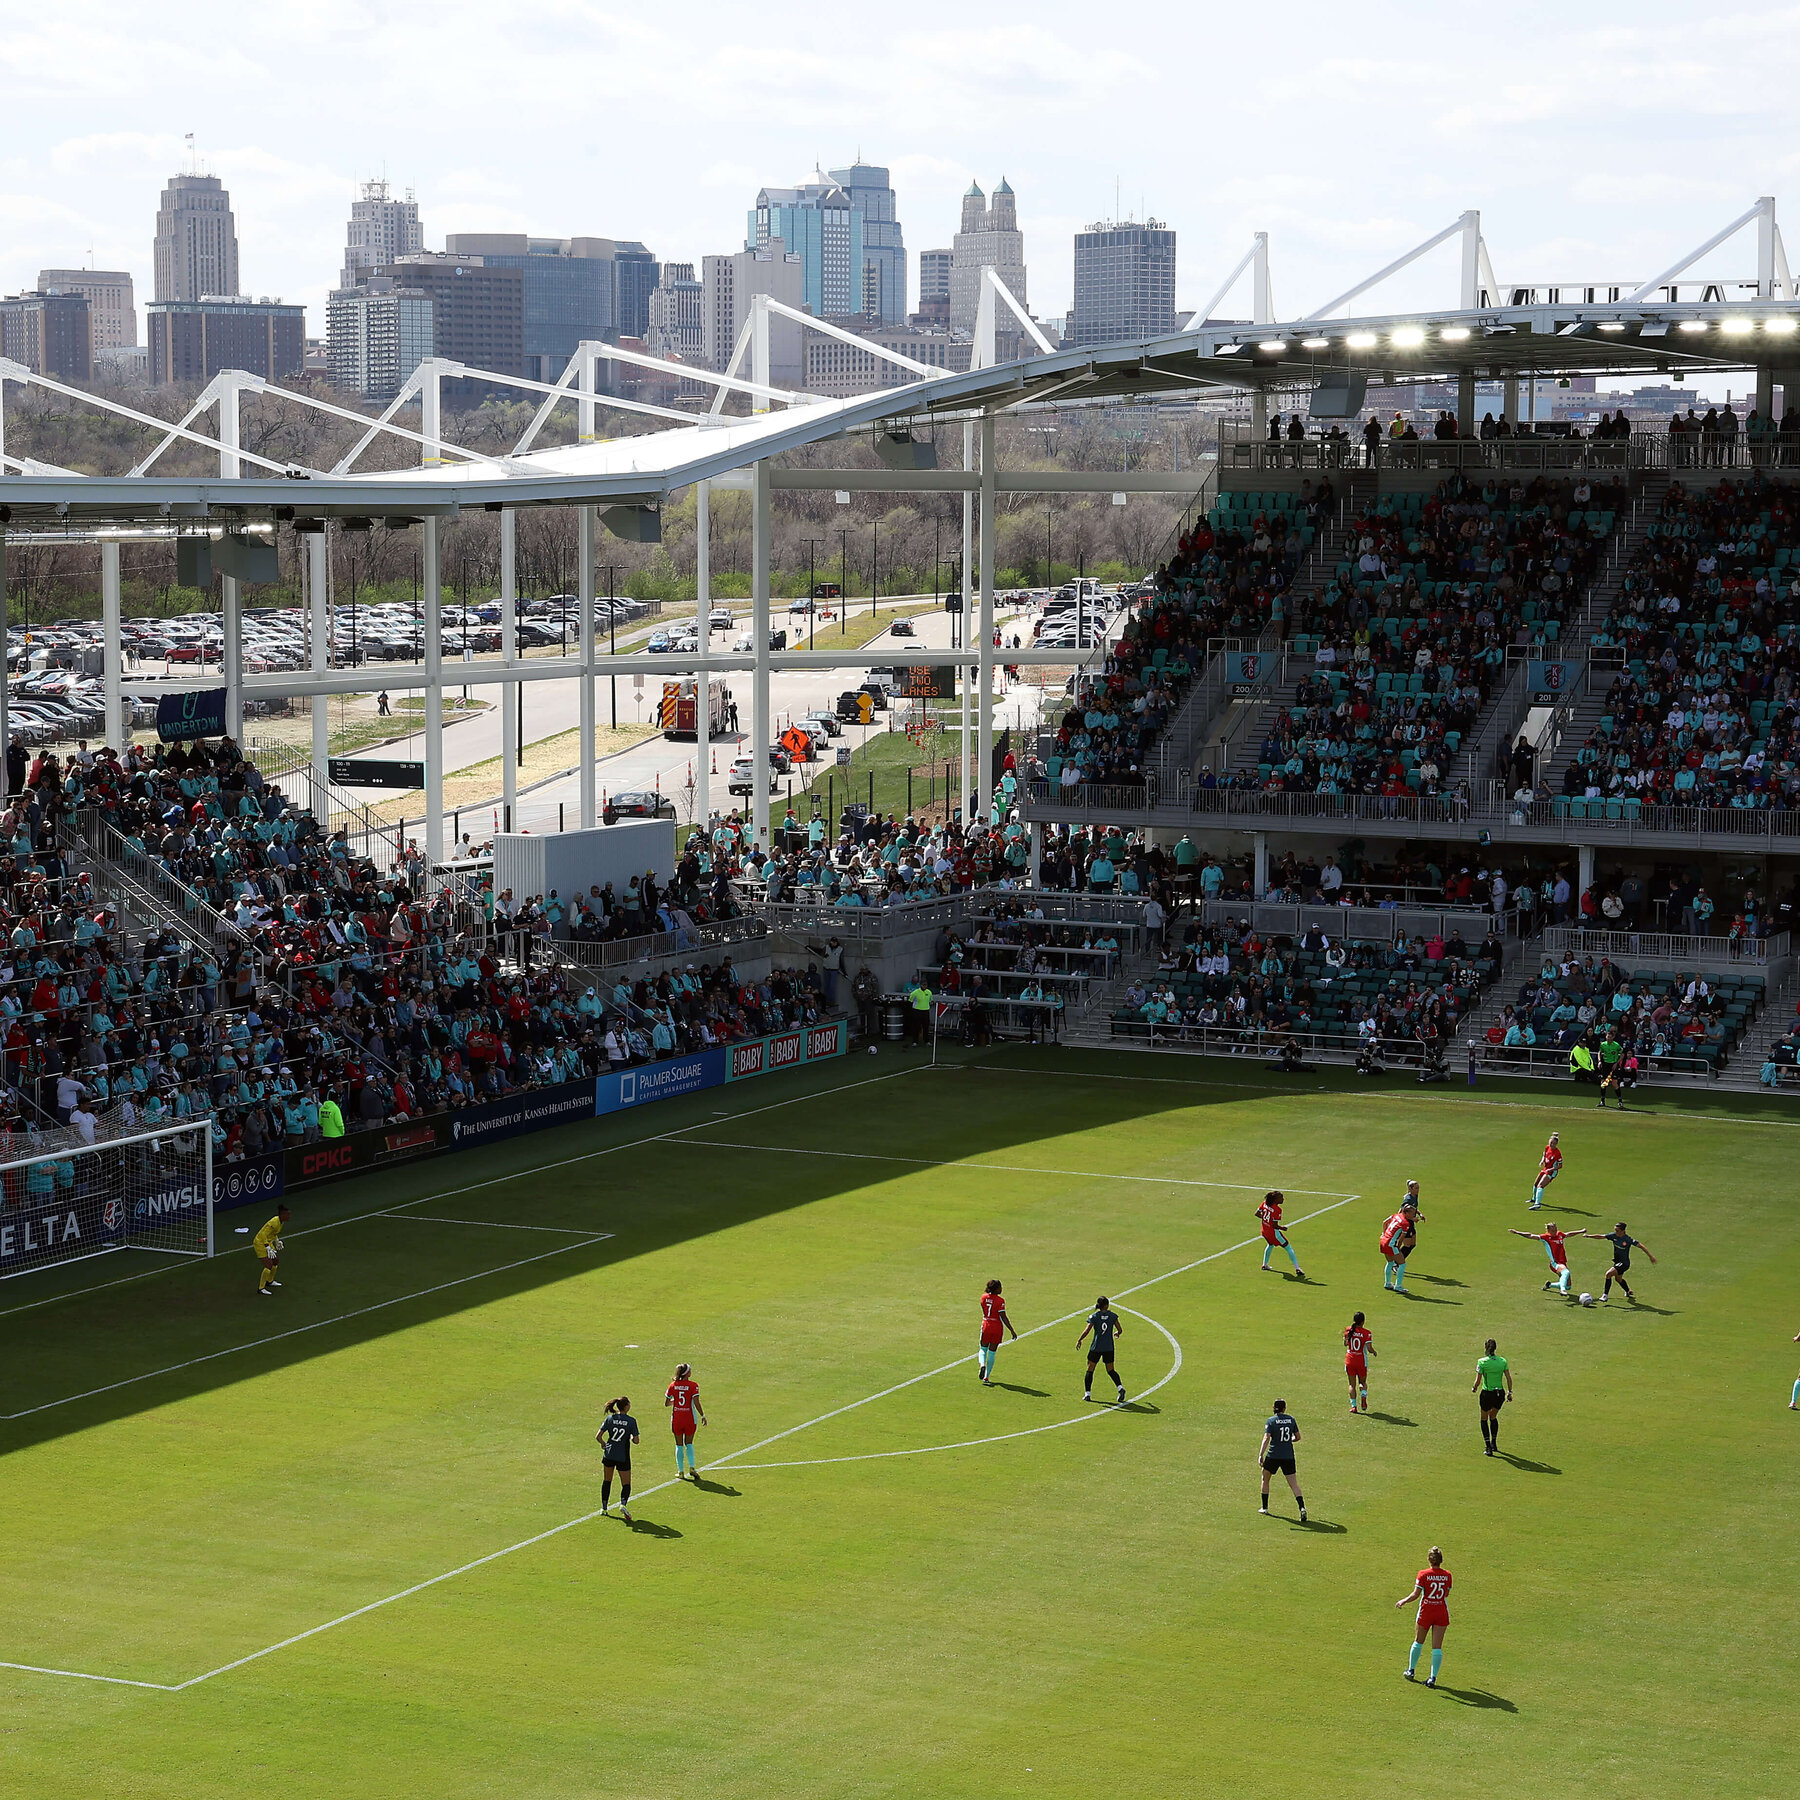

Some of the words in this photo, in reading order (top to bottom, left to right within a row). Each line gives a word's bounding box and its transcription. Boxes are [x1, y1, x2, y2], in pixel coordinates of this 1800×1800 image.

[909, 665, 931, 675] USE
[910, 676, 931, 685] TWO
[902, 686, 938, 696] LANES
[1538, 694, 1552, 702] 201
[684, 712, 689, 720] 1
[159, 716, 219, 736] UNDERTOW
[814, 1028, 838, 1055] BABY
[775, 1036, 800, 1064] BABY
[739, 1044, 763, 1072] BABY
[639, 1071, 671, 1089] PALMER
[671, 1063, 702, 1083] SQUARE
[639, 1090, 661, 1100] CAPITAL
[663, 1080, 701, 1095] MANAGEMENT
[462, 1124, 476, 1136] THE
[476, 1114, 513, 1133] UNIVERSITY
[513, 1112, 522, 1123] OF
[524, 1106, 548, 1120] KANSAS
[548, 1100, 572, 1114] HEALTH
[572, 1095, 594, 1109] SYSTEM
[303, 1146, 353, 1175] CPKC
[134, 1185, 204, 1219] @NWSL
[1263, 1209, 1271, 1223] 24
[986, 1303, 992, 1317] 7
[1101, 1322, 1108, 1335] 9
[1350, 1337, 1361, 1351] 10
[678, 1391, 686, 1406] 5
[611, 1427, 626, 1442] 22
[1279, 1426, 1290, 1442] 13
[1428, 1582, 1445, 1600] 25
